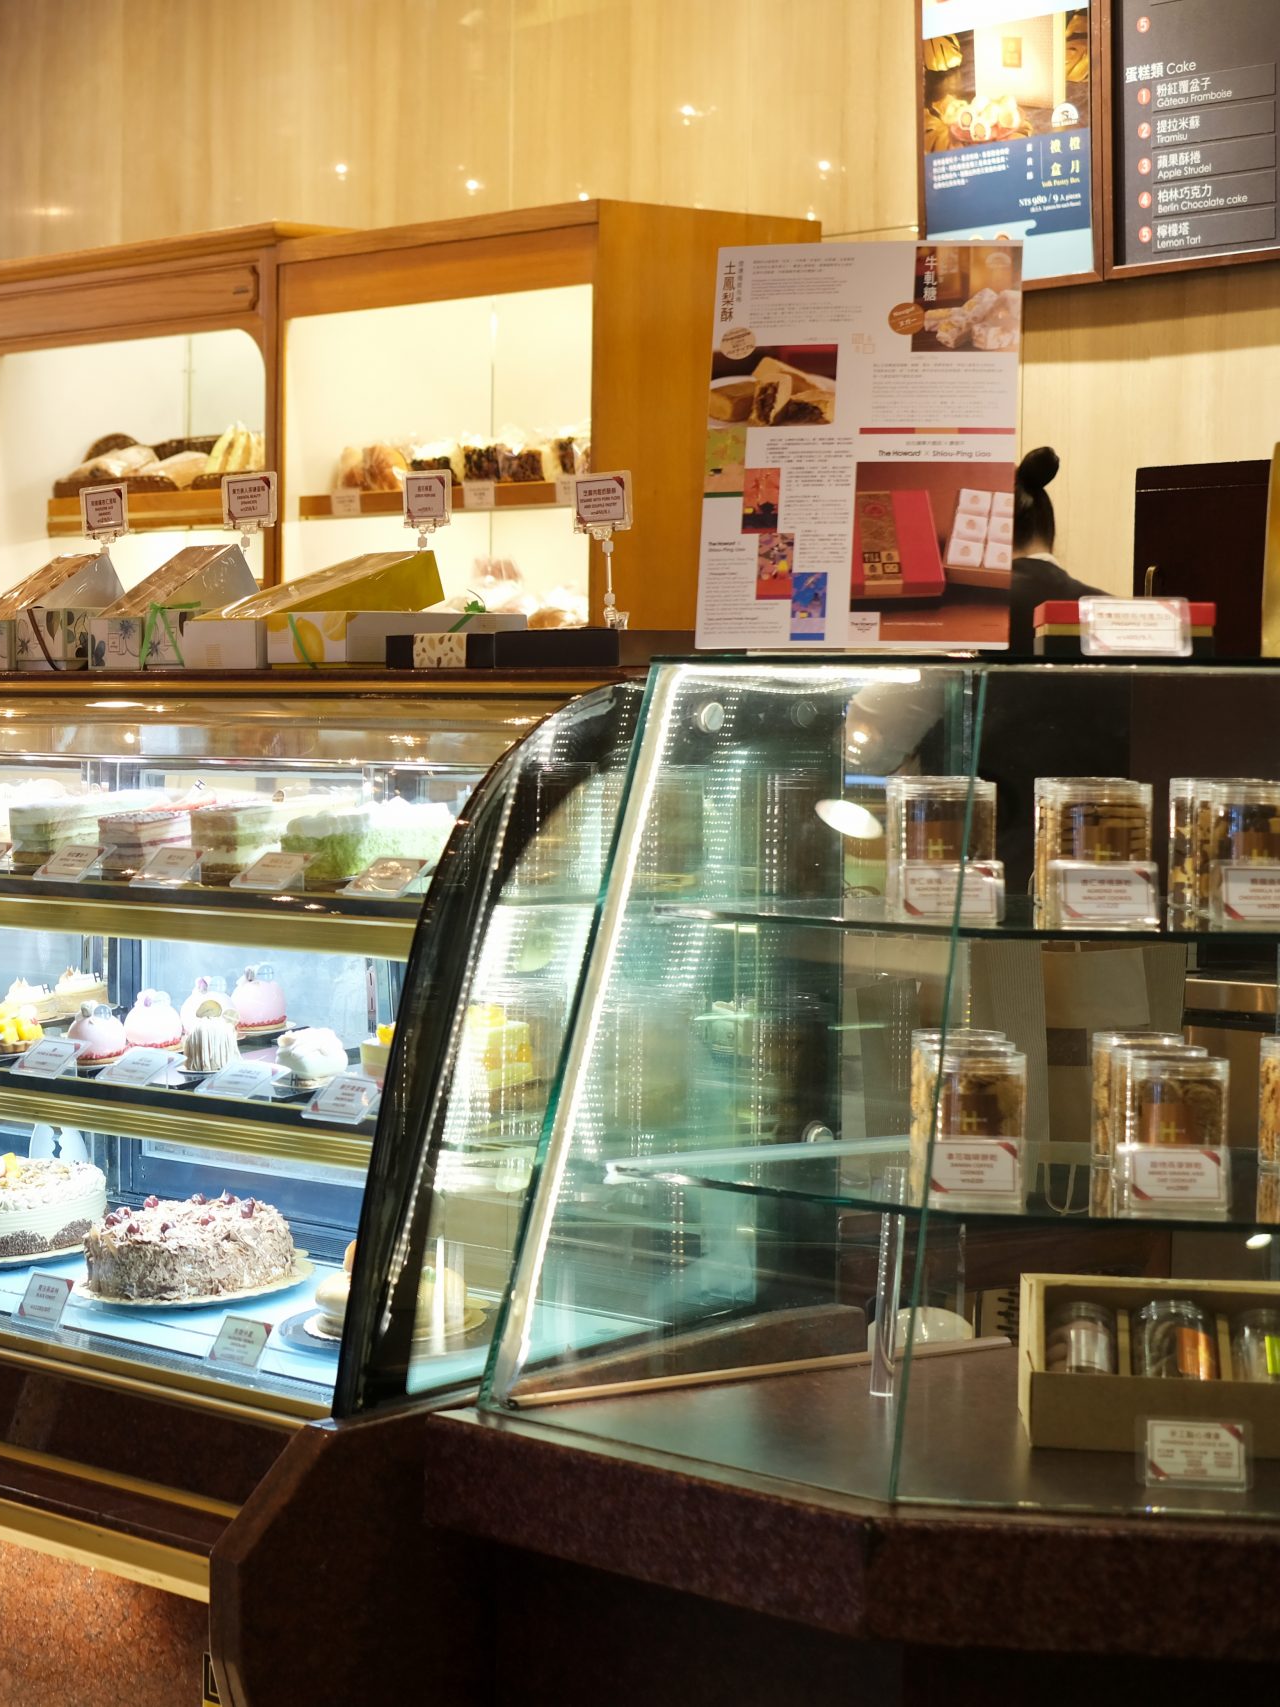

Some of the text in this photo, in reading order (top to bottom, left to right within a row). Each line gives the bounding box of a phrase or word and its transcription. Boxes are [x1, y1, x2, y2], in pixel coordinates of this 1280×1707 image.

[1125, 61, 1197, 83] 蛋糕類 Cake
[1156, 89, 1233, 108] Gâteau Framboise
[1156, 115, 1200, 134] 提拉米蘇
[1156, 133, 1188, 144] Tiramisu
[1157, 163, 1212, 180] Apple Strudel
[1157, 184, 1212, 203] 柏林巧克力
[1157, 194, 1248, 214] Berlin Chocolate cake
[1157, 222, 1190, 238] 檸檬塔
[1157, 235, 1201, 249] Lemon Tart
[922, 255, 938, 301] 牛軋糖
[720, 260, 736, 323] 土鳳梨酥
[878, 449, 891, 457] The
[892, 449, 921, 457] Howard
